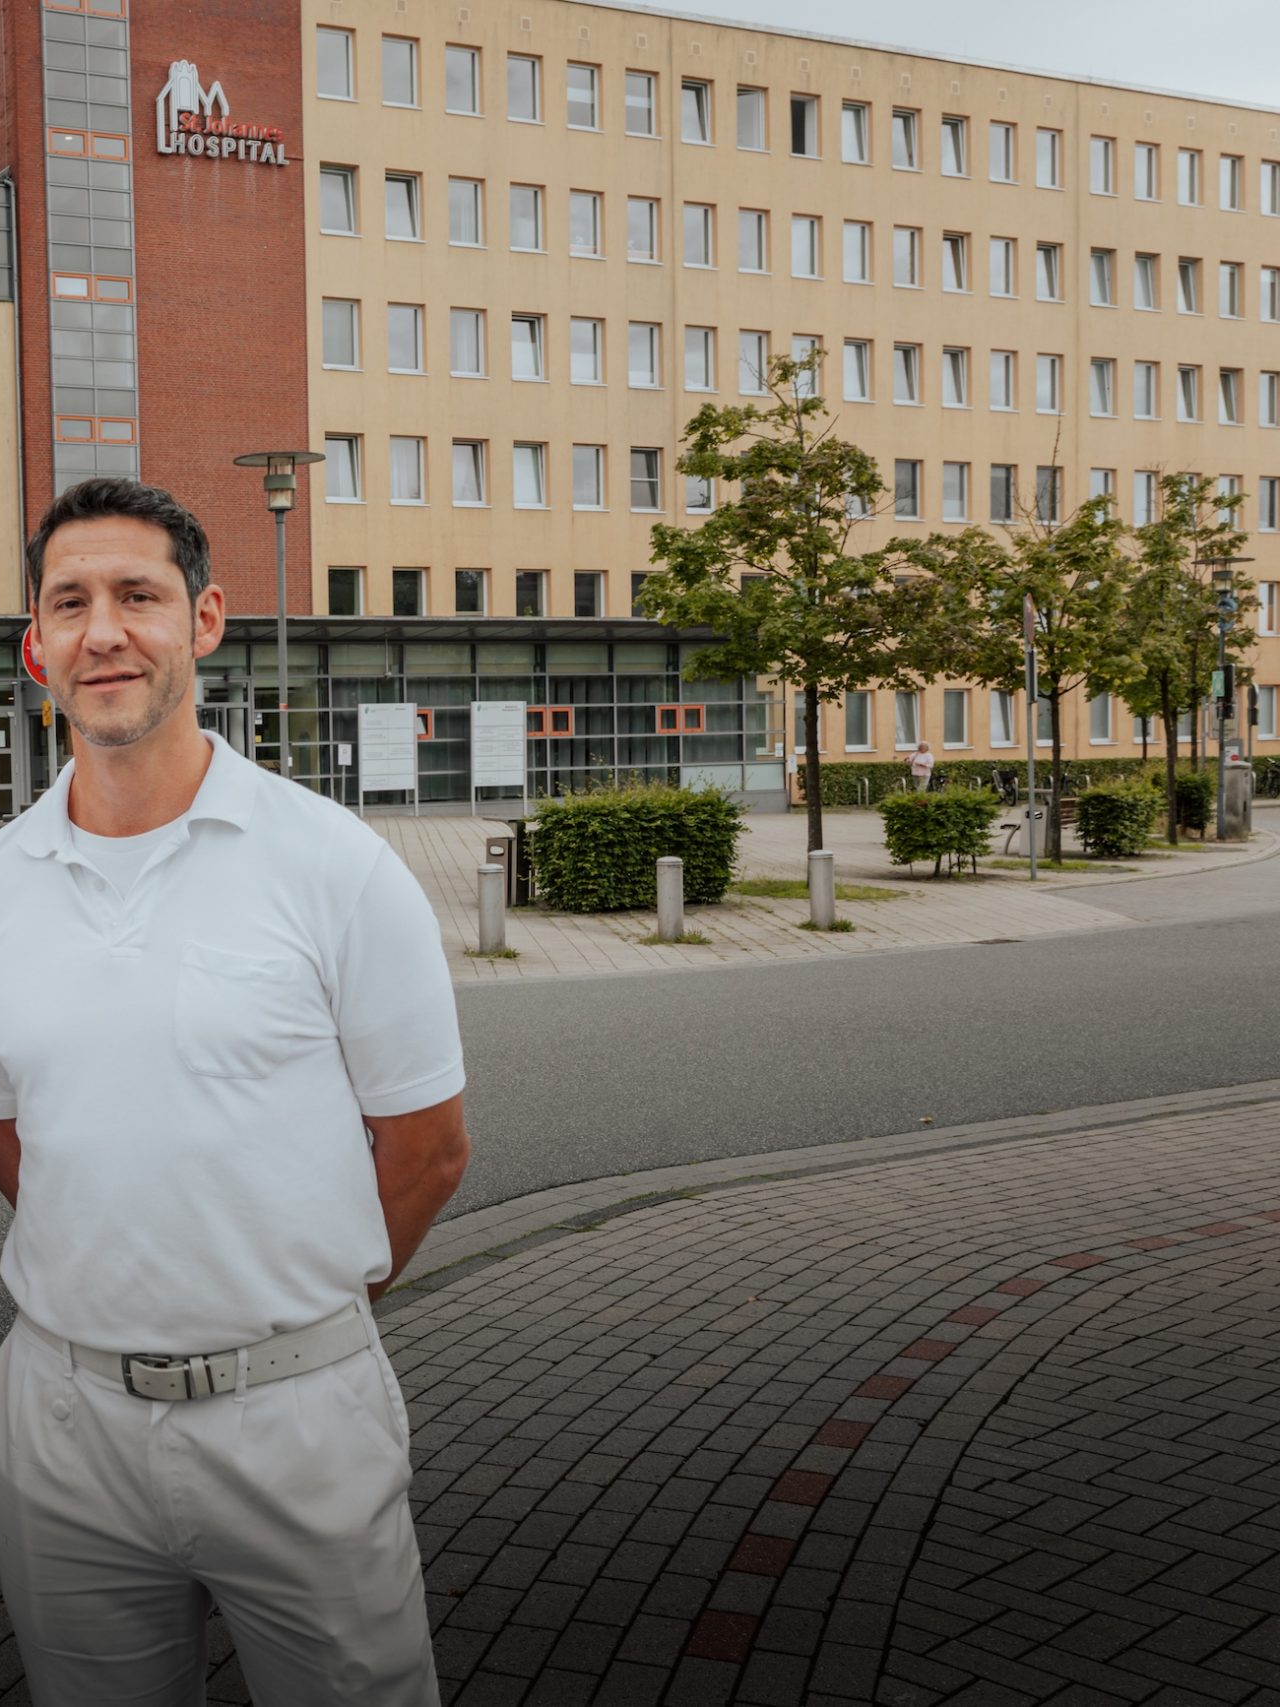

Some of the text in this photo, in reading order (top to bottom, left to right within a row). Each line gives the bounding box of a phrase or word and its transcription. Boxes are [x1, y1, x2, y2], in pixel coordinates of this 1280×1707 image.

[179, 112, 283, 140] St. Johannes
[172, 132, 290, 165] HOSPITAL
